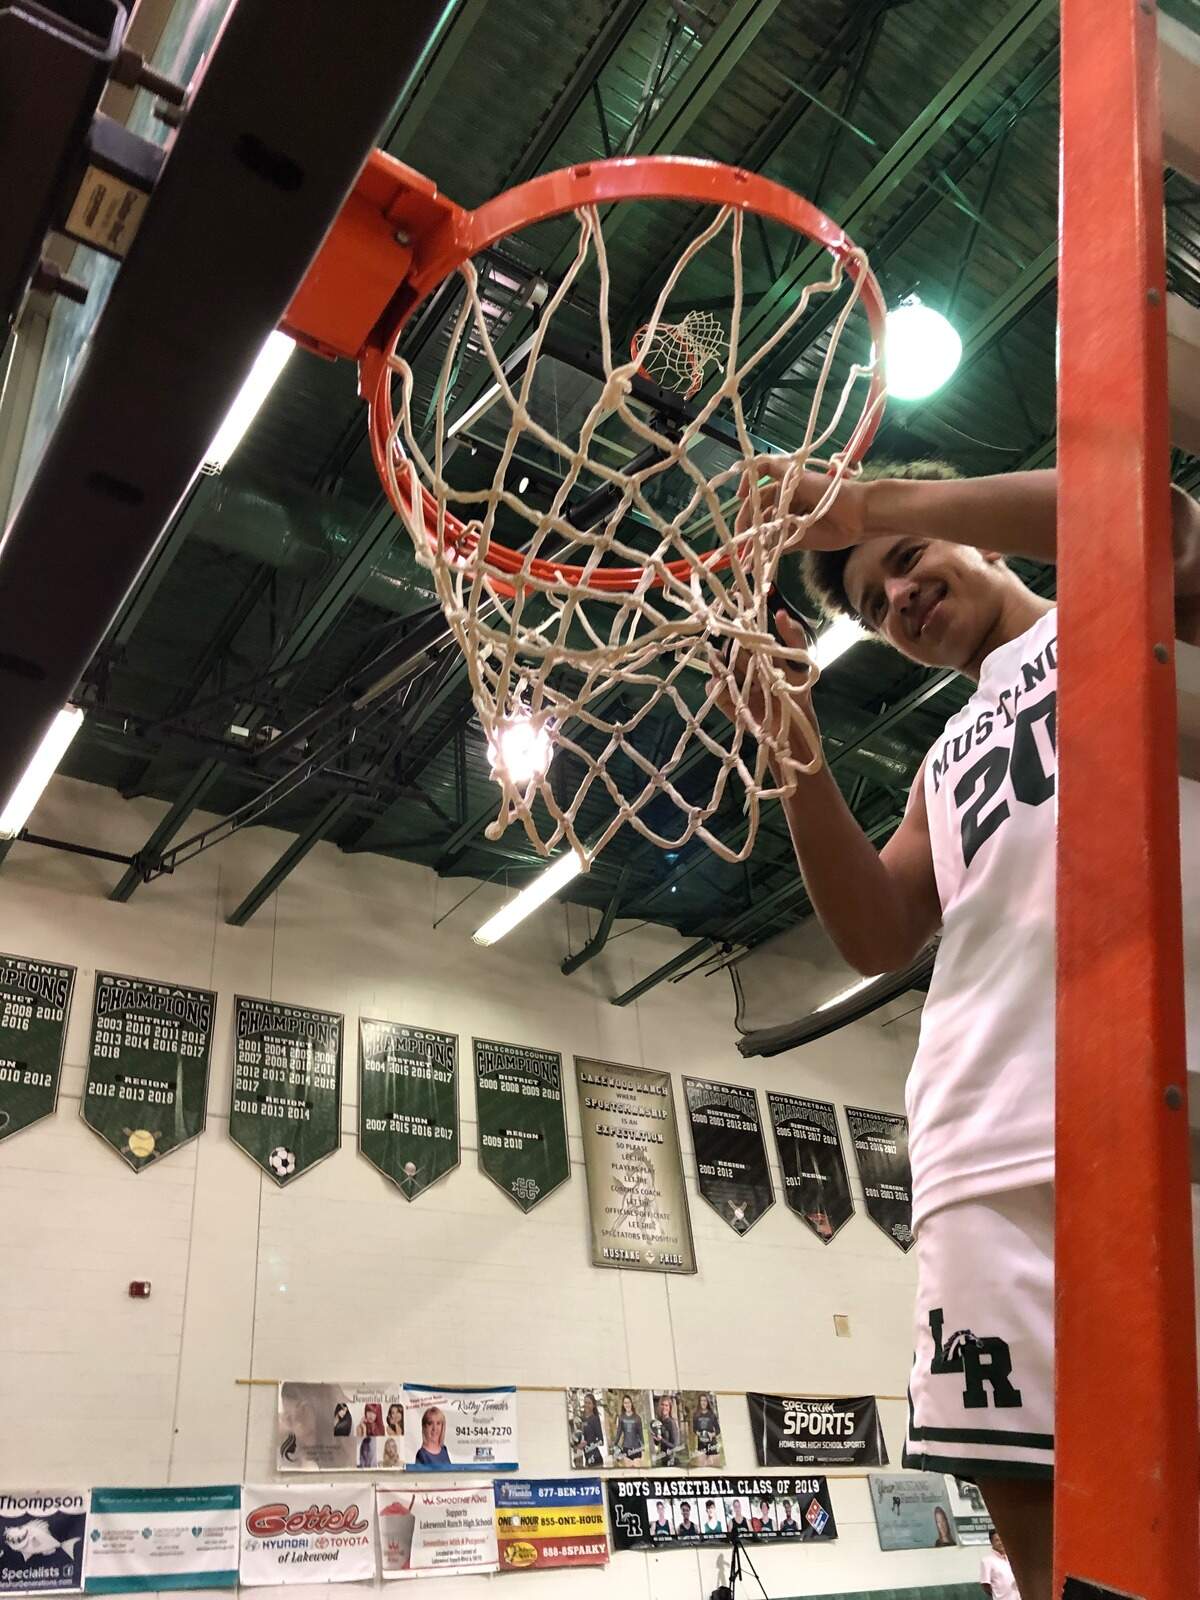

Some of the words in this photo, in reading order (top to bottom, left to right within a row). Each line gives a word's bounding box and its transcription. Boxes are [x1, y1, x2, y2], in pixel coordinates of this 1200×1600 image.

[953, 690, 1056, 869] 20
[6, 960, 68, 977] TENNIS
[0, 967, 69, 1010] PIONS
[102, 976, 210, 1003] SOFTBALL
[5, 1003, 32, 1018] 2008
[36, 1006, 63, 1021] 2010
[96, 985, 211, 1034] CHAMPIONS
[241, 1001, 280, 1015] GIRLS
[284, 1009, 339, 1024] SOCCER
[1, 1014, 29, 1030] 2016
[126, 1013, 180, 1028] DISTRICT
[97, 1017, 122, 1031] 2003
[126, 1021, 151, 1036] 2010
[155, 1026, 179, 1040] 2011
[182, 1030, 206, 1045] 2012
[237, 1009, 339, 1056] CHAMPIONS
[414, 1031, 453, 1044] GOLF
[95, 1030, 121, 1045] 2013
[125, 1034, 149, 1050] 2014
[153, 1038, 178, 1053] 2016
[180, 1043, 205, 1058] 2017
[239, 1039, 261, 1052] 2001
[264, 1043, 286, 1057] 2004
[263, 1035, 313, 1048] DISTRICT
[94, 1044, 120, 1059] 2018
[364, 1031, 454, 1074] CHAMPIONS
[477, 1042, 499, 1052] GIRLS
[500, 1046, 524, 1056] CROSS
[525, 1051, 558, 1061] COUNTRY
[239, 1051, 261, 1064] 2007
[265, 1055, 287, 1069] 2008
[289, 1059, 312, 1072] 2010
[314, 1063, 336, 1077] 2011
[387, 1055, 432, 1068] DISTRICT
[476, 1050, 560, 1090] CHAMPIONS
[23, 1071, 51, 1087] 2012
[236, 1064, 260, 1078] 2012
[262, 1068, 286, 1082] 2013
[289, 1072, 311, 1086] 2014
[365, 1060, 385, 1073] 2004
[389, 1063, 409, 1076] 2015
[411, 1066, 431, 1080] 2016
[433, 1070, 452, 1083] 2017
[498, 1074, 539, 1085] DISTRICT
[125, 1076, 169, 1089] REGION
[236, 1077, 260, 1092] 2017
[580, 1072, 634, 1091] LAKEWOOD
[636, 1083, 668, 1097] RANCH
[687, 1080, 753, 1097] BASEBALL
[89, 1082, 115, 1097] 2012
[119, 1087, 144, 1101] 2013
[148, 1090, 174, 1105] 2018
[266, 1095, 305, 1107] REGION
[542, 1087, 560, 1100] 2010
[234, 1100, 258, 1114] 2010
[261, 1103, 284, 1118] 2013
[287, 1106, 310, 1121] 2014
[585, 1097, 668, 1120] SPORTSMANSHIP
[770, 1095, 788, 1103] BOYS
[789, 1099, 832, 1112] BASKETBALL
[393, 1113, 428, 1124] REGION
[366, 1118, 387, 1131] 2007
[390, 1120, 409, 1134] 2015
[412, 1124, 432, 1137] 2016
[434, 1127, 453, 1140] 2017
[506, 1129, 539, 1140] REGION
[504, 1137, 523, 1150] 2010
[603, 1247, 640, 1262] MUSTANG
[660, 1253, 683, 1266] PRIDE
[929, 1308, 1022, 1408] LR
[782, 1400, 835, 1413] SPECTRUM
[456, 1426, 512, 1436] 941-544-7270
[783, 1411, 855, 1435] SPORTS
[779, 1441, 795, 1449] HOME
[808, 1441, 822, 1449] HIGH
[822, 1441, 843, 1449] SCHOOL
[843, 1440, 866, 1448] SPORTS
[538, 1486, 600, 1498] 877-BEN-1776
[618, 1481, 650, 1497] BOYS
[654, 1480, 734, 1496] BASKETBALL
[737, 1480, 773, 1494] CLASS
[777, 1480, 790, 1494] OF
[795, 1479, 820, 1494] 2019
[0, 1495, 83, 1512] Thompson
[246, 1503, 369, 1538] Gettel
[446, 1509, 468, 1518] Supports
[498, 1517, 511, 1526] ONE
[520, 1516, 539, 1526] HOUR
[540, 1515, 603, 1527] 855-ONE-HOUR
[420, 1520, 447, 1529] Lakewood
[447, 1519, 462, 1528] Ranch
[463, 1519, 474, 1528] High
[475, 1518, 493, 1527] School
[262, 1539, 308, 1549] HYUNDAI
[331, 1536, 369, 1547] TOYOTA
[543, 1544, 606, 1558] 888-8SPARKY
[278, 1551, 291, 1564] of
[291, 1550, 340, 1563] Lakewood
[2, 1566, 60, 1582] Specialists
